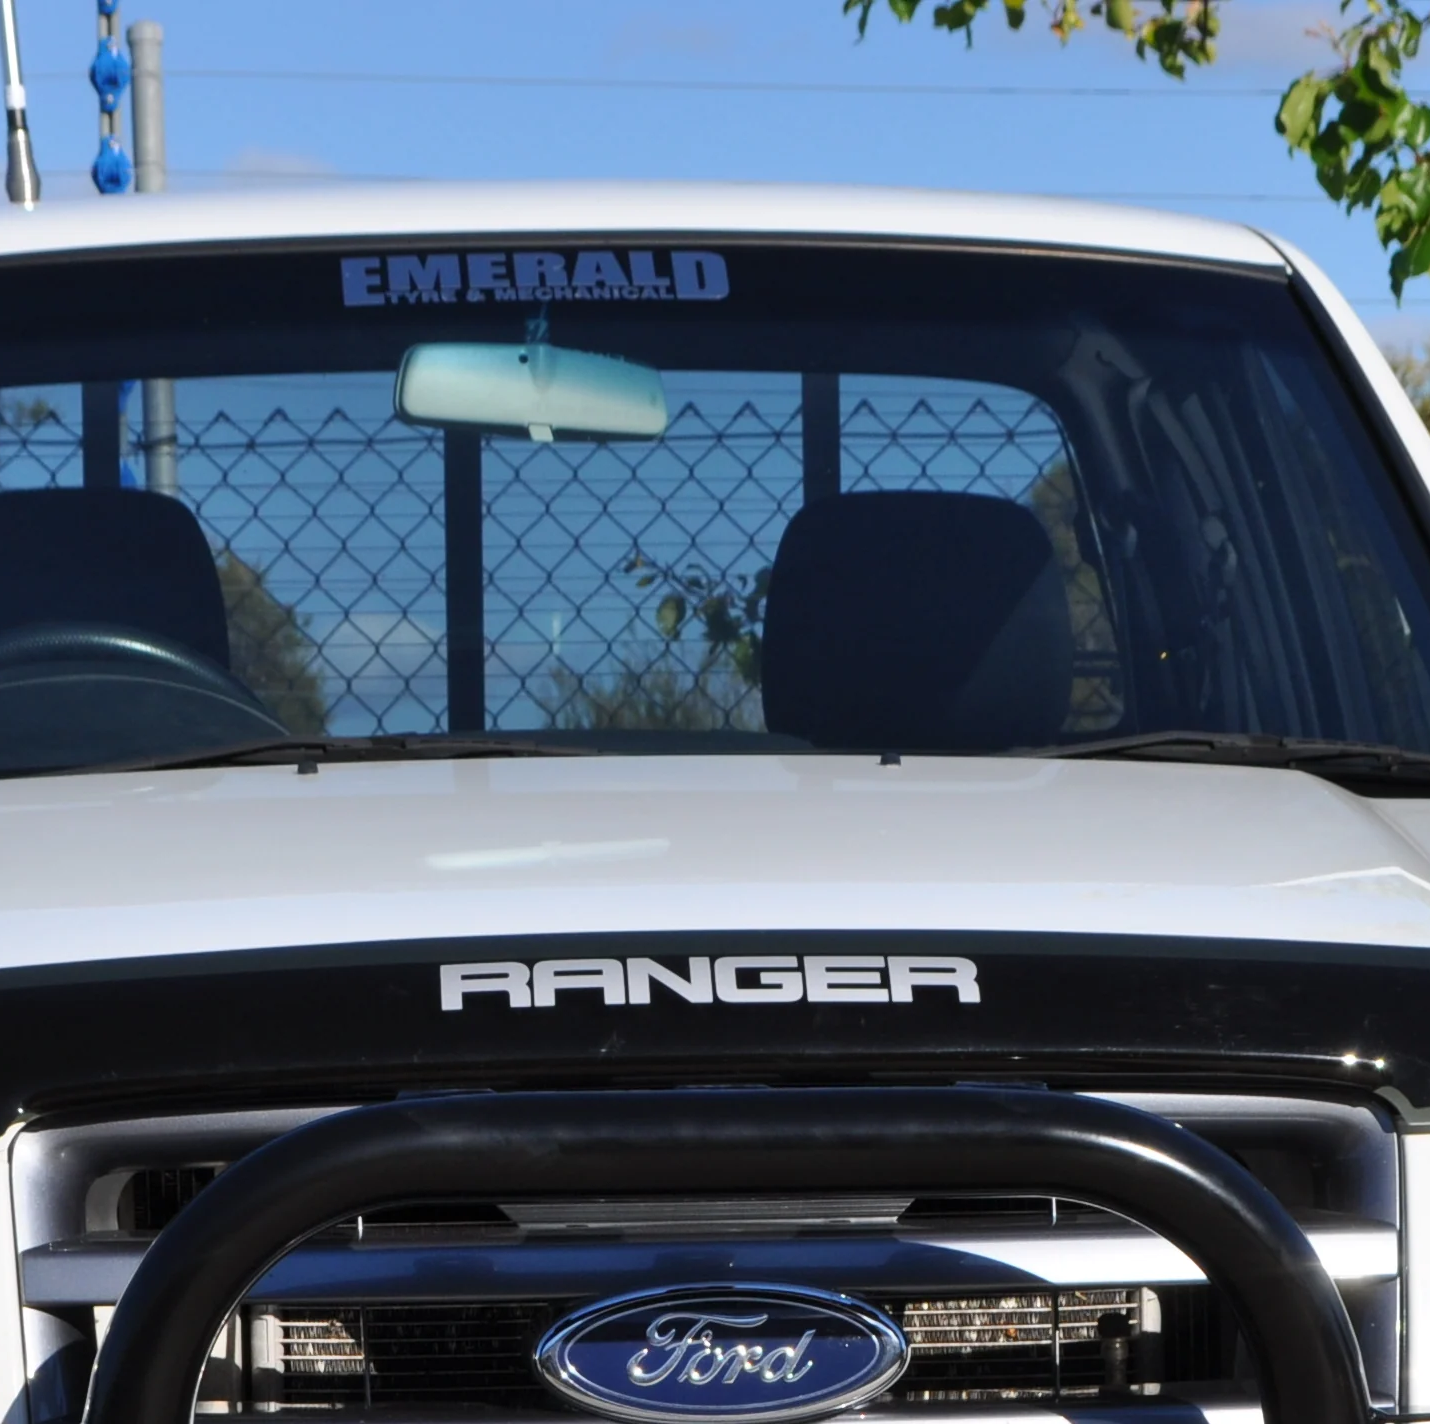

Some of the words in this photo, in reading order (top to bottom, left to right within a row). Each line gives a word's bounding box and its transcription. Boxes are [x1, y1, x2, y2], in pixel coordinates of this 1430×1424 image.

[340, 251, 730, 306] EMERALD
[494, 283, 674, 301] MECHANICAL
[440, 956, 980, 1010] RANGER
[627, 1313, 816, 1386] Ford
